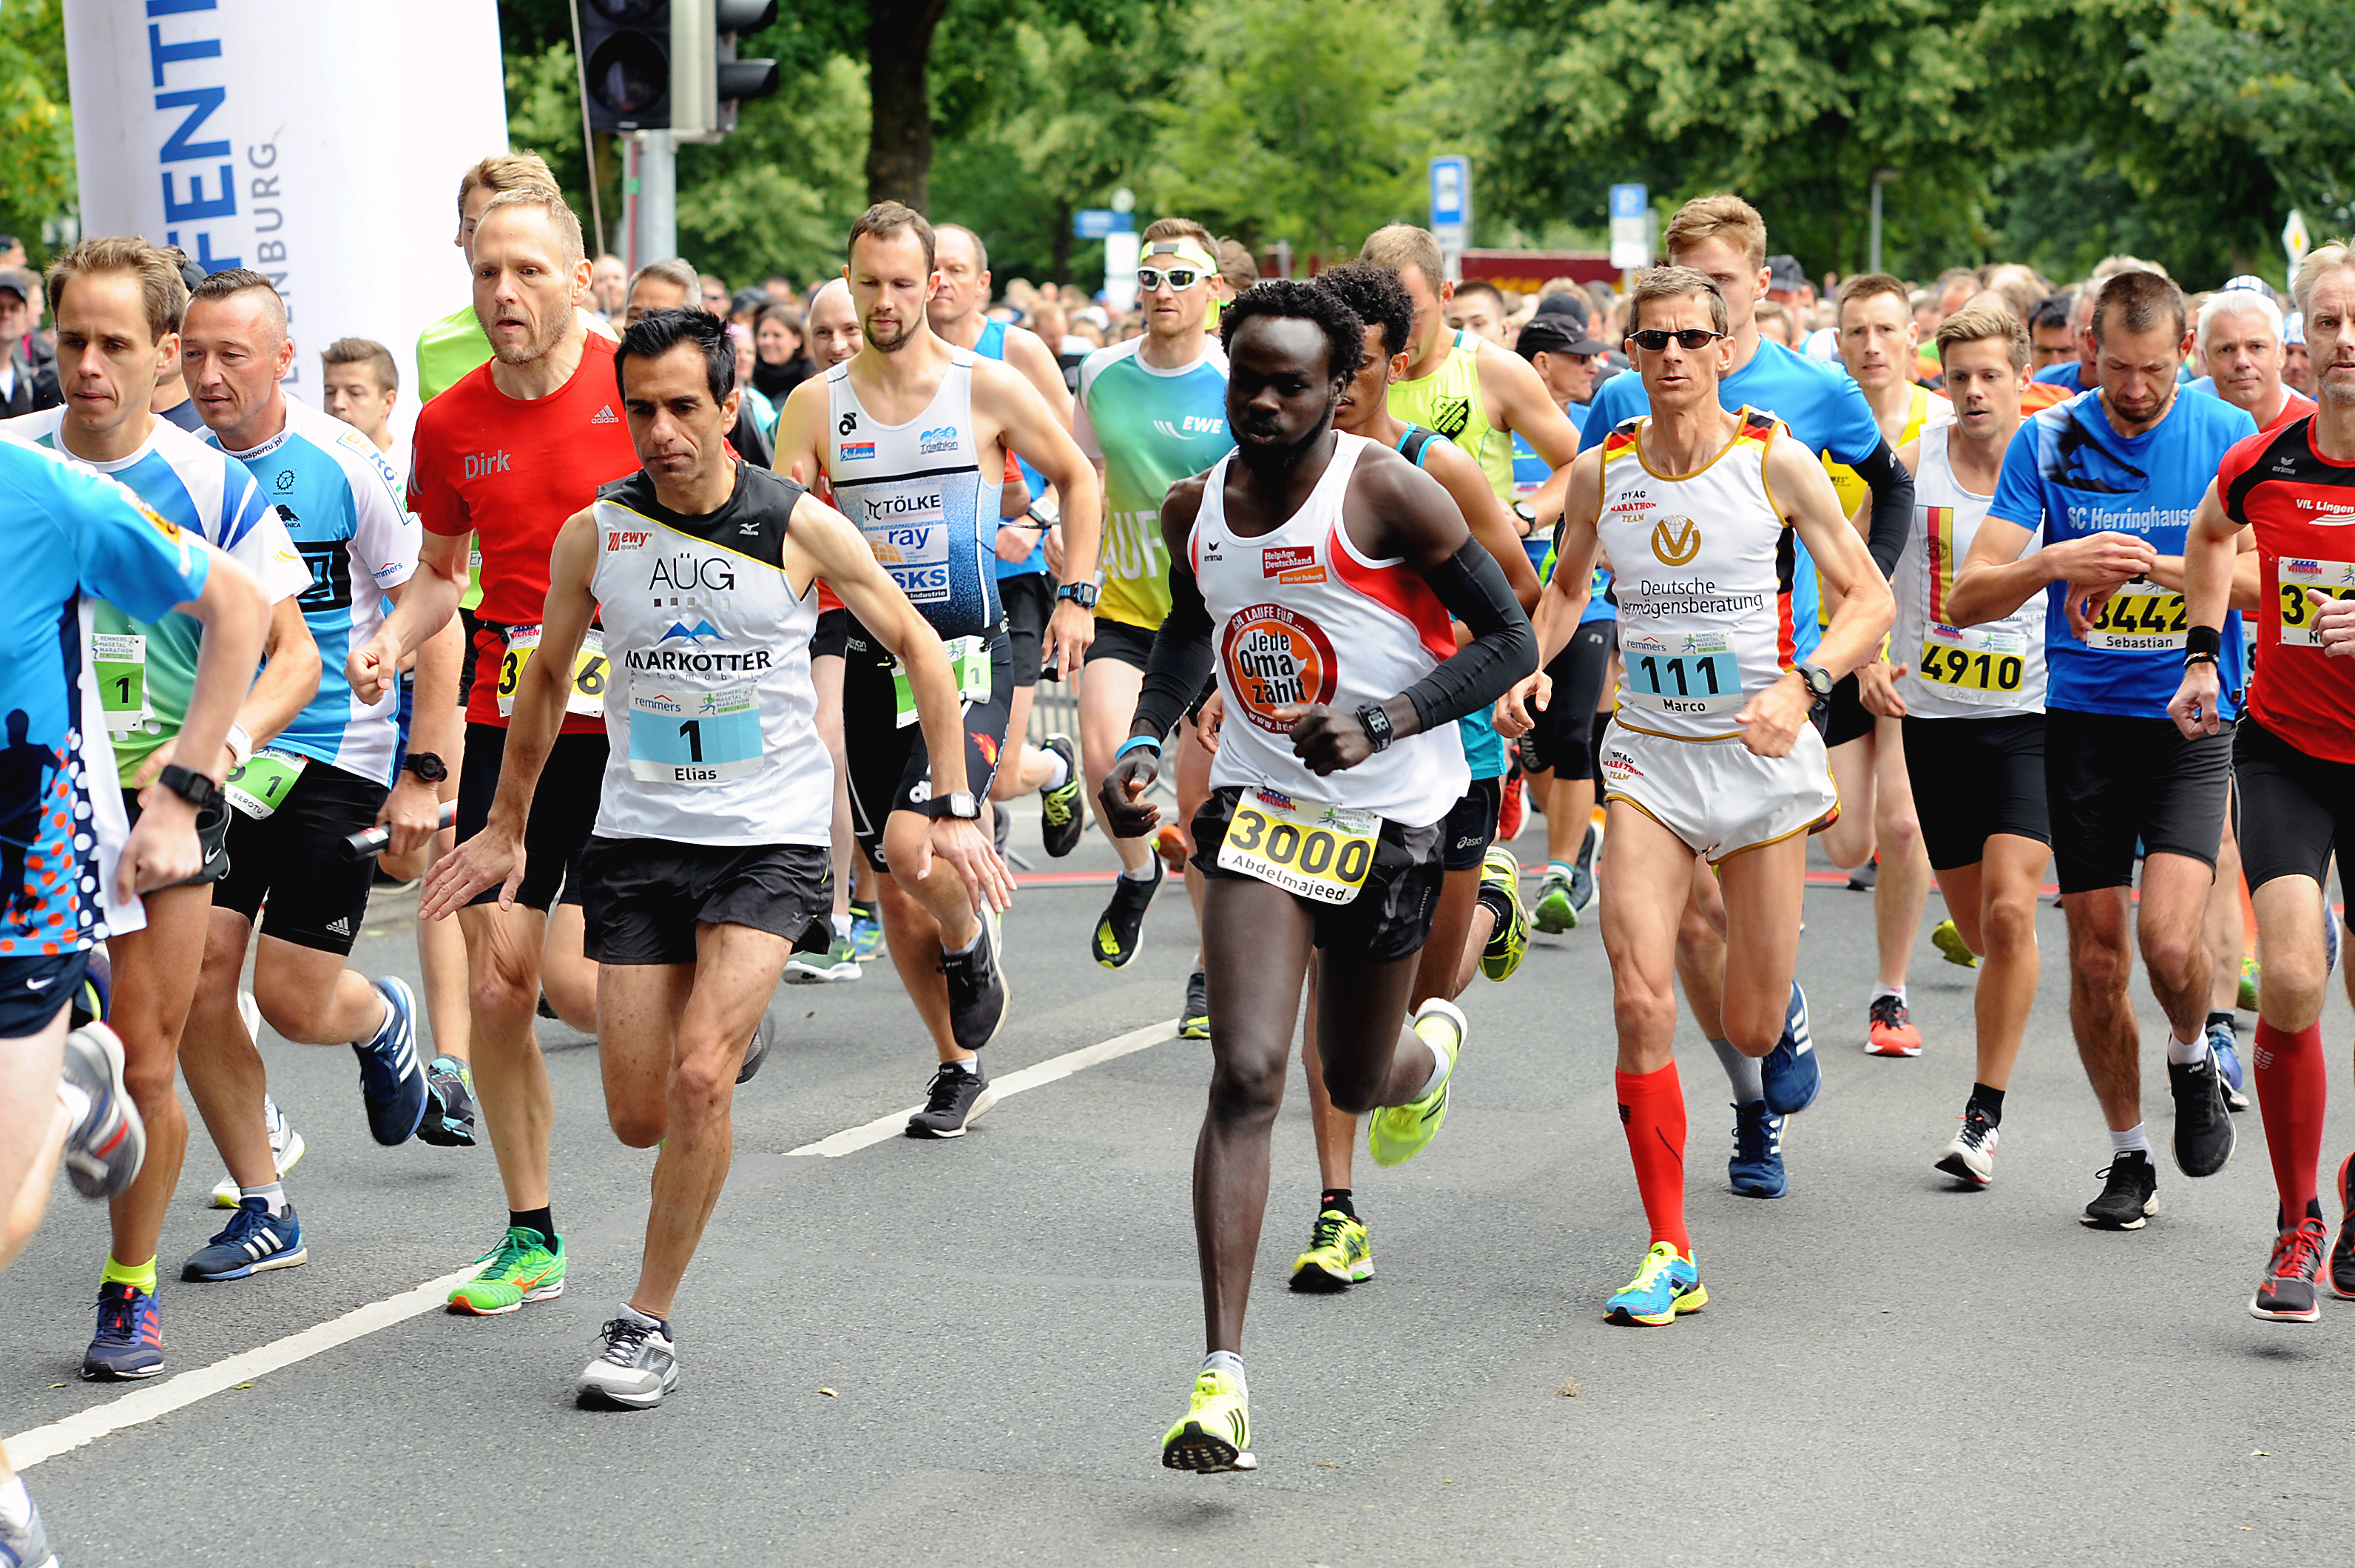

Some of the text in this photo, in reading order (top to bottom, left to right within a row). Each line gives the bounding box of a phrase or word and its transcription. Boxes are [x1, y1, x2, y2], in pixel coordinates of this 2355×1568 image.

[1182, 416, 1223, 435] EWE
[464, 450, 511, 479] Dirk
[883, 494, 941, 513] TÖLKE
[1610, 502, 1657, 512] MARATHON
[2296, 499, 2354, 515] VfL Lingen
[1622, 513, 1645, 523] TEAM
[2067, 505, 2195, 534] SC Herringhause
[621, 531, 649, 547] ewy
[888, 527, 930, 550] ray
[1265, 550, 1296, 561] HelpAge
[1266, 556, 1313, 569] Deutschland
[372, 562, 403, 579] emmers
[649, 552, 734, 590] AÜG
[2287, 565, 2322, 575] WILKEN
[910, 591, 946, 599] Industrie
[1641, 577, 1715, 596] Deutsche
[1277, 607, 1294, 624] FÜR
[509, 629, 541, 640] WILKEN
[1249, 630, 1289, 652] Jede
[1933, 628, 1963, 641] WILKEN
[2106, 635, 2174, 649] Sebastian
[1626, 641, 1667, 652] remmers
[624, 649, 773, 672] MARKÖTTER
[1239, 649, 1294, 678] Oma
[1921, 645, 2021, 690] 4910
[970, 667, 980, 685] 1
[1641, 655, 1720, 697] 111
[116, 677, 129, 704] 1
[716, 689, 742, 697] REMMERS
[716, 695, 742, 703] HASETAL
[1251, 677, 1308, 704] zählt
[635, 696, 682, 713] remmers
[717, 697, 750, 708] MARATHON
[1663, 698, 1706, 712] Marco
[679, 720, 703, 763] 1
[675, 767, 717, 781] Elias
[1609, 771, 1631, 780] TEAM
[266, 775, 283, 798] 1
[232, 792, 264, 814] BEROTU
[1257, 792, 1297, 811] WILKEN
[1229, 810, 1371, 883] 3000
[1232, 854, 1348, 902] Abdelmajeed
[325, 924, 351, 936] adidas
